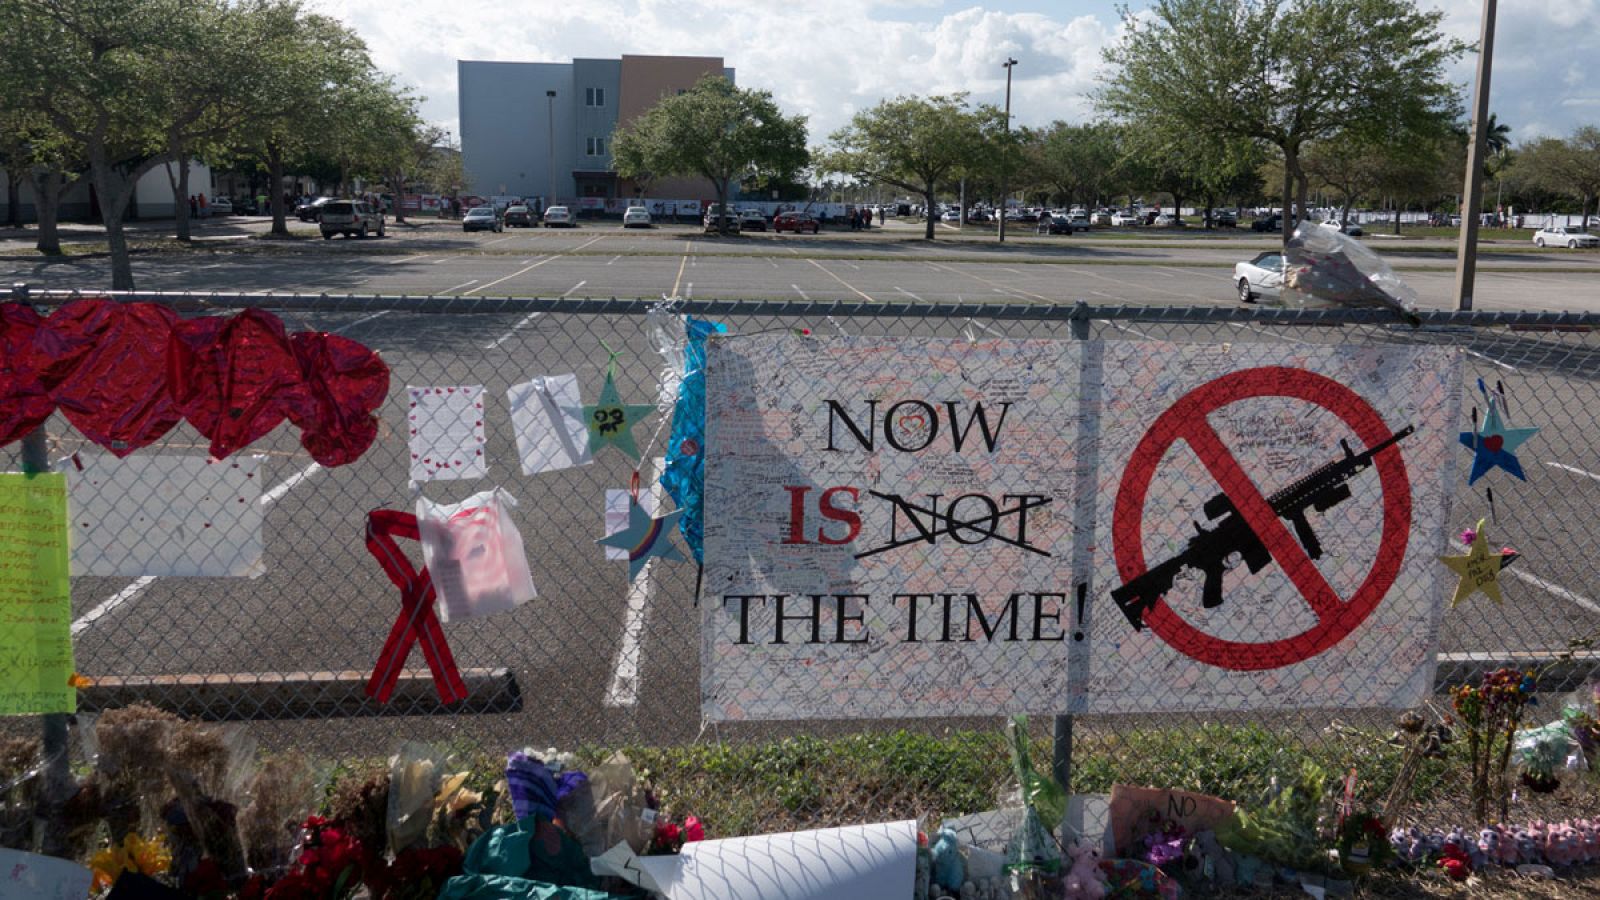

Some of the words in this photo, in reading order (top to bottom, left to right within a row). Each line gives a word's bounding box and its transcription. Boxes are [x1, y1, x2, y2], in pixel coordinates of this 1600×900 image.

[824, 399, 1013, 453] NOW
[782, 486, 863, 545] IS
[885, 494, 1048, 545] NOT
[723, 594, 869, 645] THE
[892, 582, 1088, 643] TIME!
[1167, 793, 1197, 817] NO
